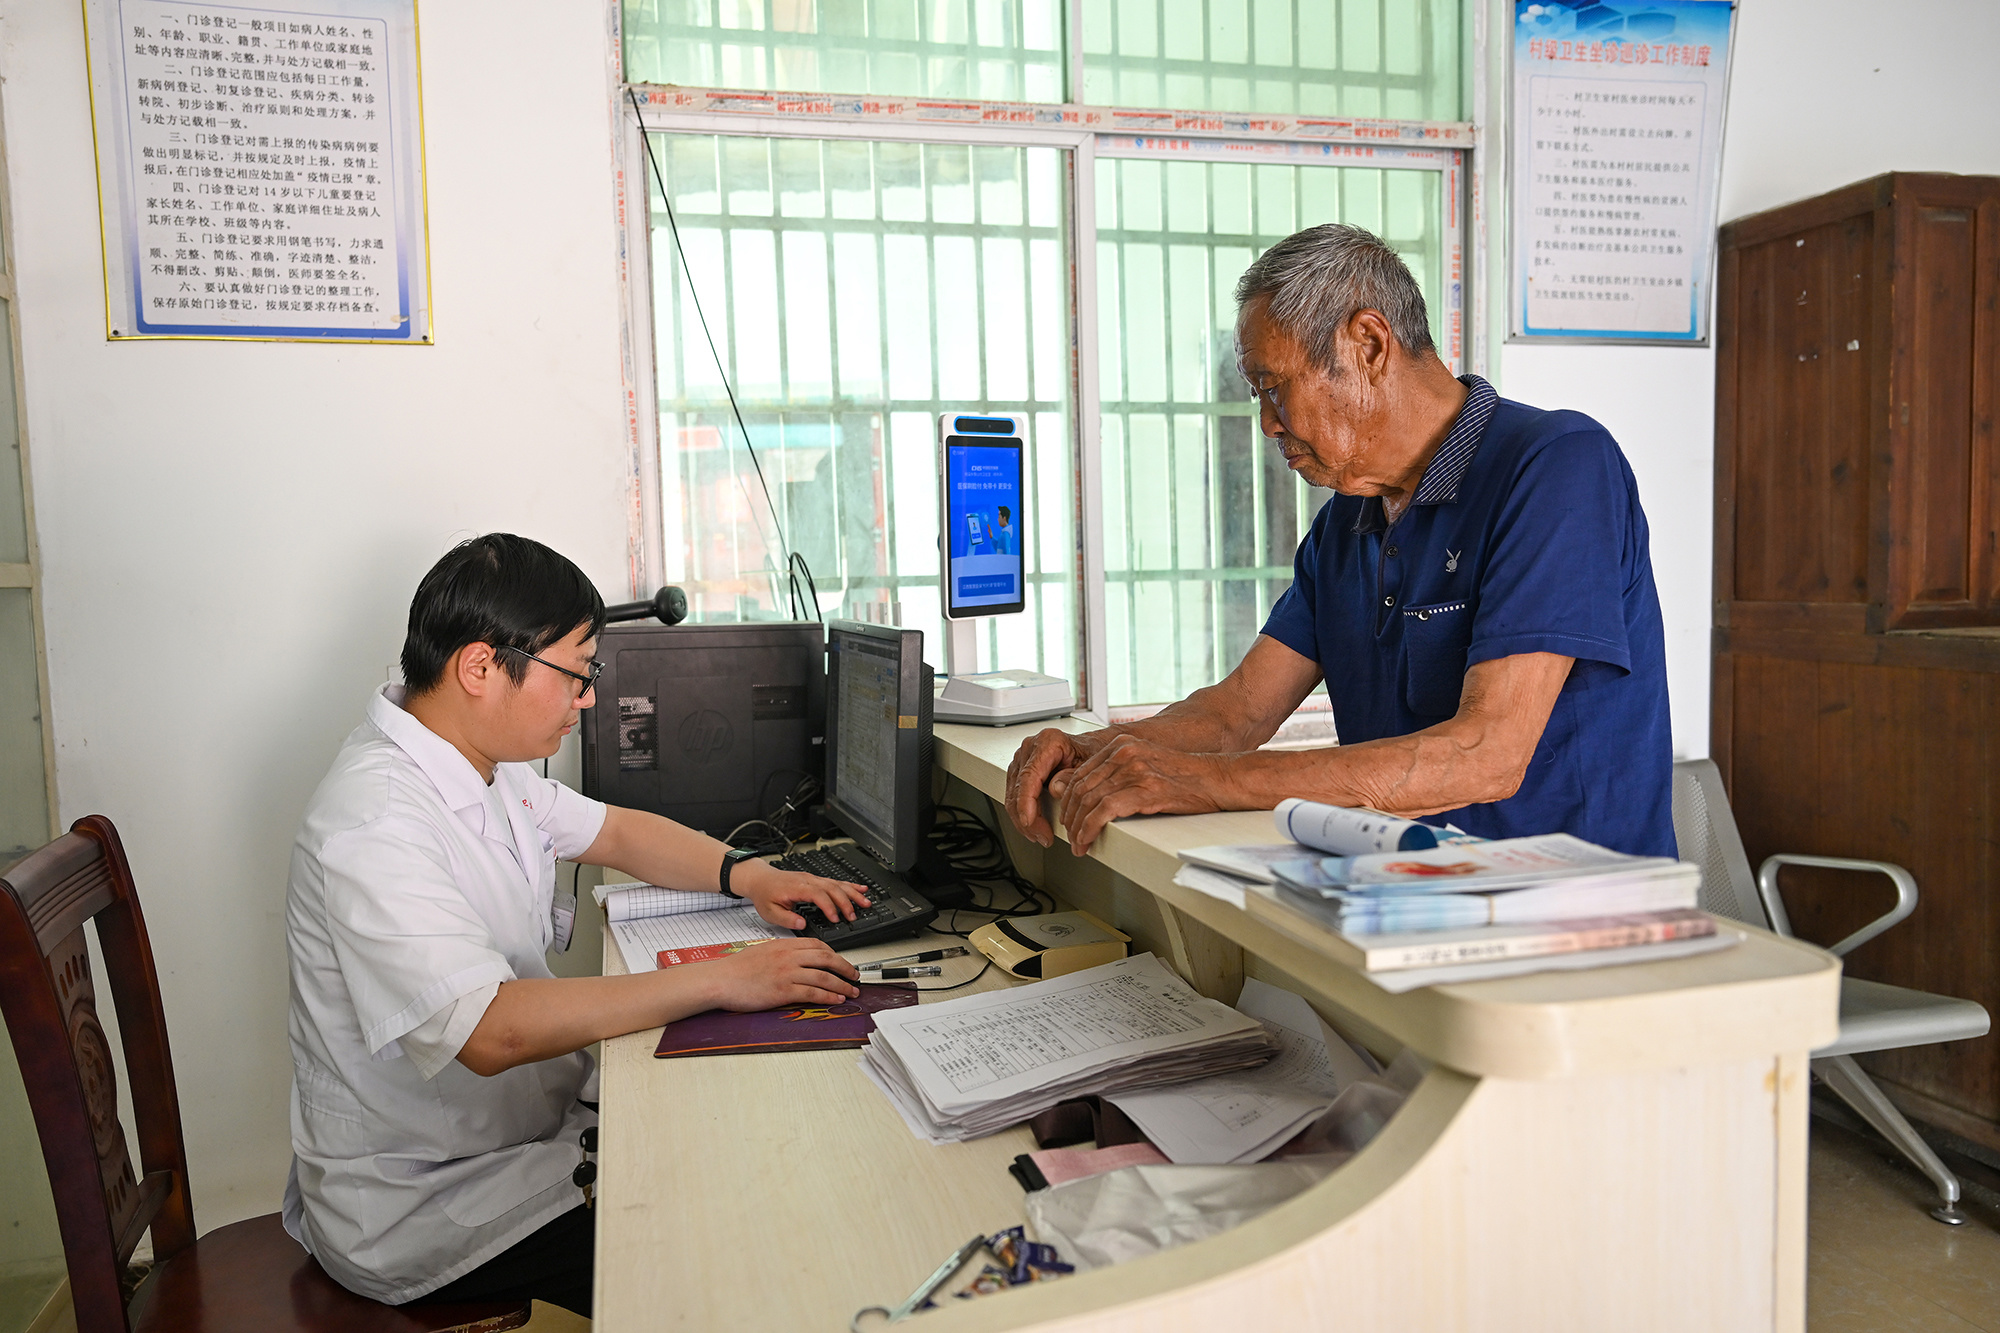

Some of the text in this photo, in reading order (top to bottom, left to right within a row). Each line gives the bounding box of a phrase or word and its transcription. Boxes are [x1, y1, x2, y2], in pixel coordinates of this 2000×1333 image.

[160, 14, 374, 40] 一、门诊登记一般项目如病人姓名、性
[134, 26, 373, 56] 别、年龄、职业、籍贯、工作单位或家庭地
[1529, 37, 1712, 67] 村级卫生坐诊巡诊工作制度
[137, 78, 375, 104] 新病例登记、初复诊登记、疾病分类、转诊
[140, 112, 248, 130] 与处方记载相一致。
[169, 131, 379, 153] 三、门诊登记对需上报的传染病病例要
[146, 197, 381, 217] 家长姓名、工作单位、家庭详细住址及病人
[147, 214, 292, 230] 其所在学校、班级等内容。
